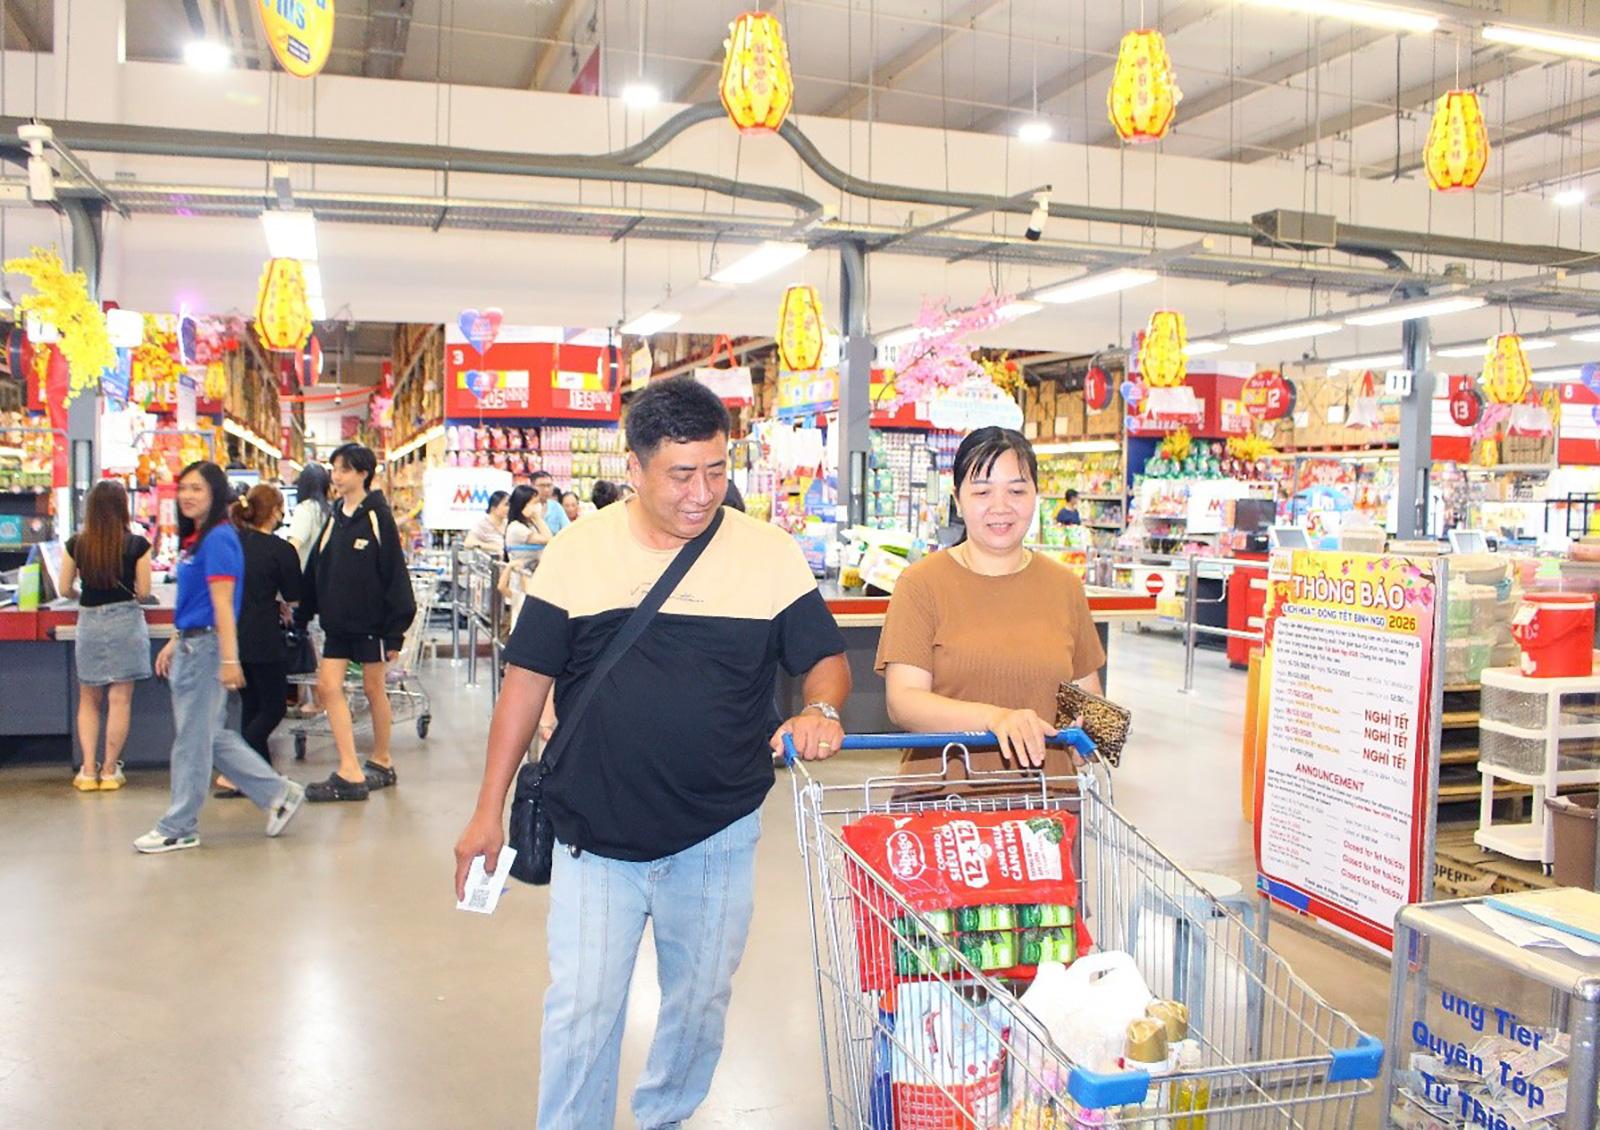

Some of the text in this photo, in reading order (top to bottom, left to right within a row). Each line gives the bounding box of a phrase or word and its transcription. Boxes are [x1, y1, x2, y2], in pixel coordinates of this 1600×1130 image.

[452, 349, 464, 366] 3
[1393, 375, 1408, 391] 11
[1267, 388, 1281, 408] 12
[1453, 401, 1470, 420] 13
[1361, 577, 1407, 611] BÁO
[1388, 615, 1416, 631] 2026
[1364, 708, 1410, 730] NGHỈ TẾT
[1363, 727, 1408, 749] NGHỈ TẾT
[1362, 747, 1407, 771] NGHỈ TẾT
[1295, 762, 1365, 793] ANNOUNCEMENT
[957, 825, 977, 842] 12
[934, 833, 947, 871] COMBO
[1007, 845, 1023, 881] CÀNG
[1343, 839, 1364, 854] Closed
[1365, 847, 1373, 857] for
[1383, 855, 1405, 872] holiday
[964, 860, 985, 882] 12
[1342, 853, 1362, 868] Closed
[1363, 862, 1372, 871] for
[1382, 869, 1405, 888] holiday
[1340, 867, 1361, 882] Closed
[1362, 876, 1370, 886] for
[1380, 884, 1404, 901] holiday
[1441, 991, 1485, 1031] ung
[1412, 1021, 1483, 1075] Quyên
